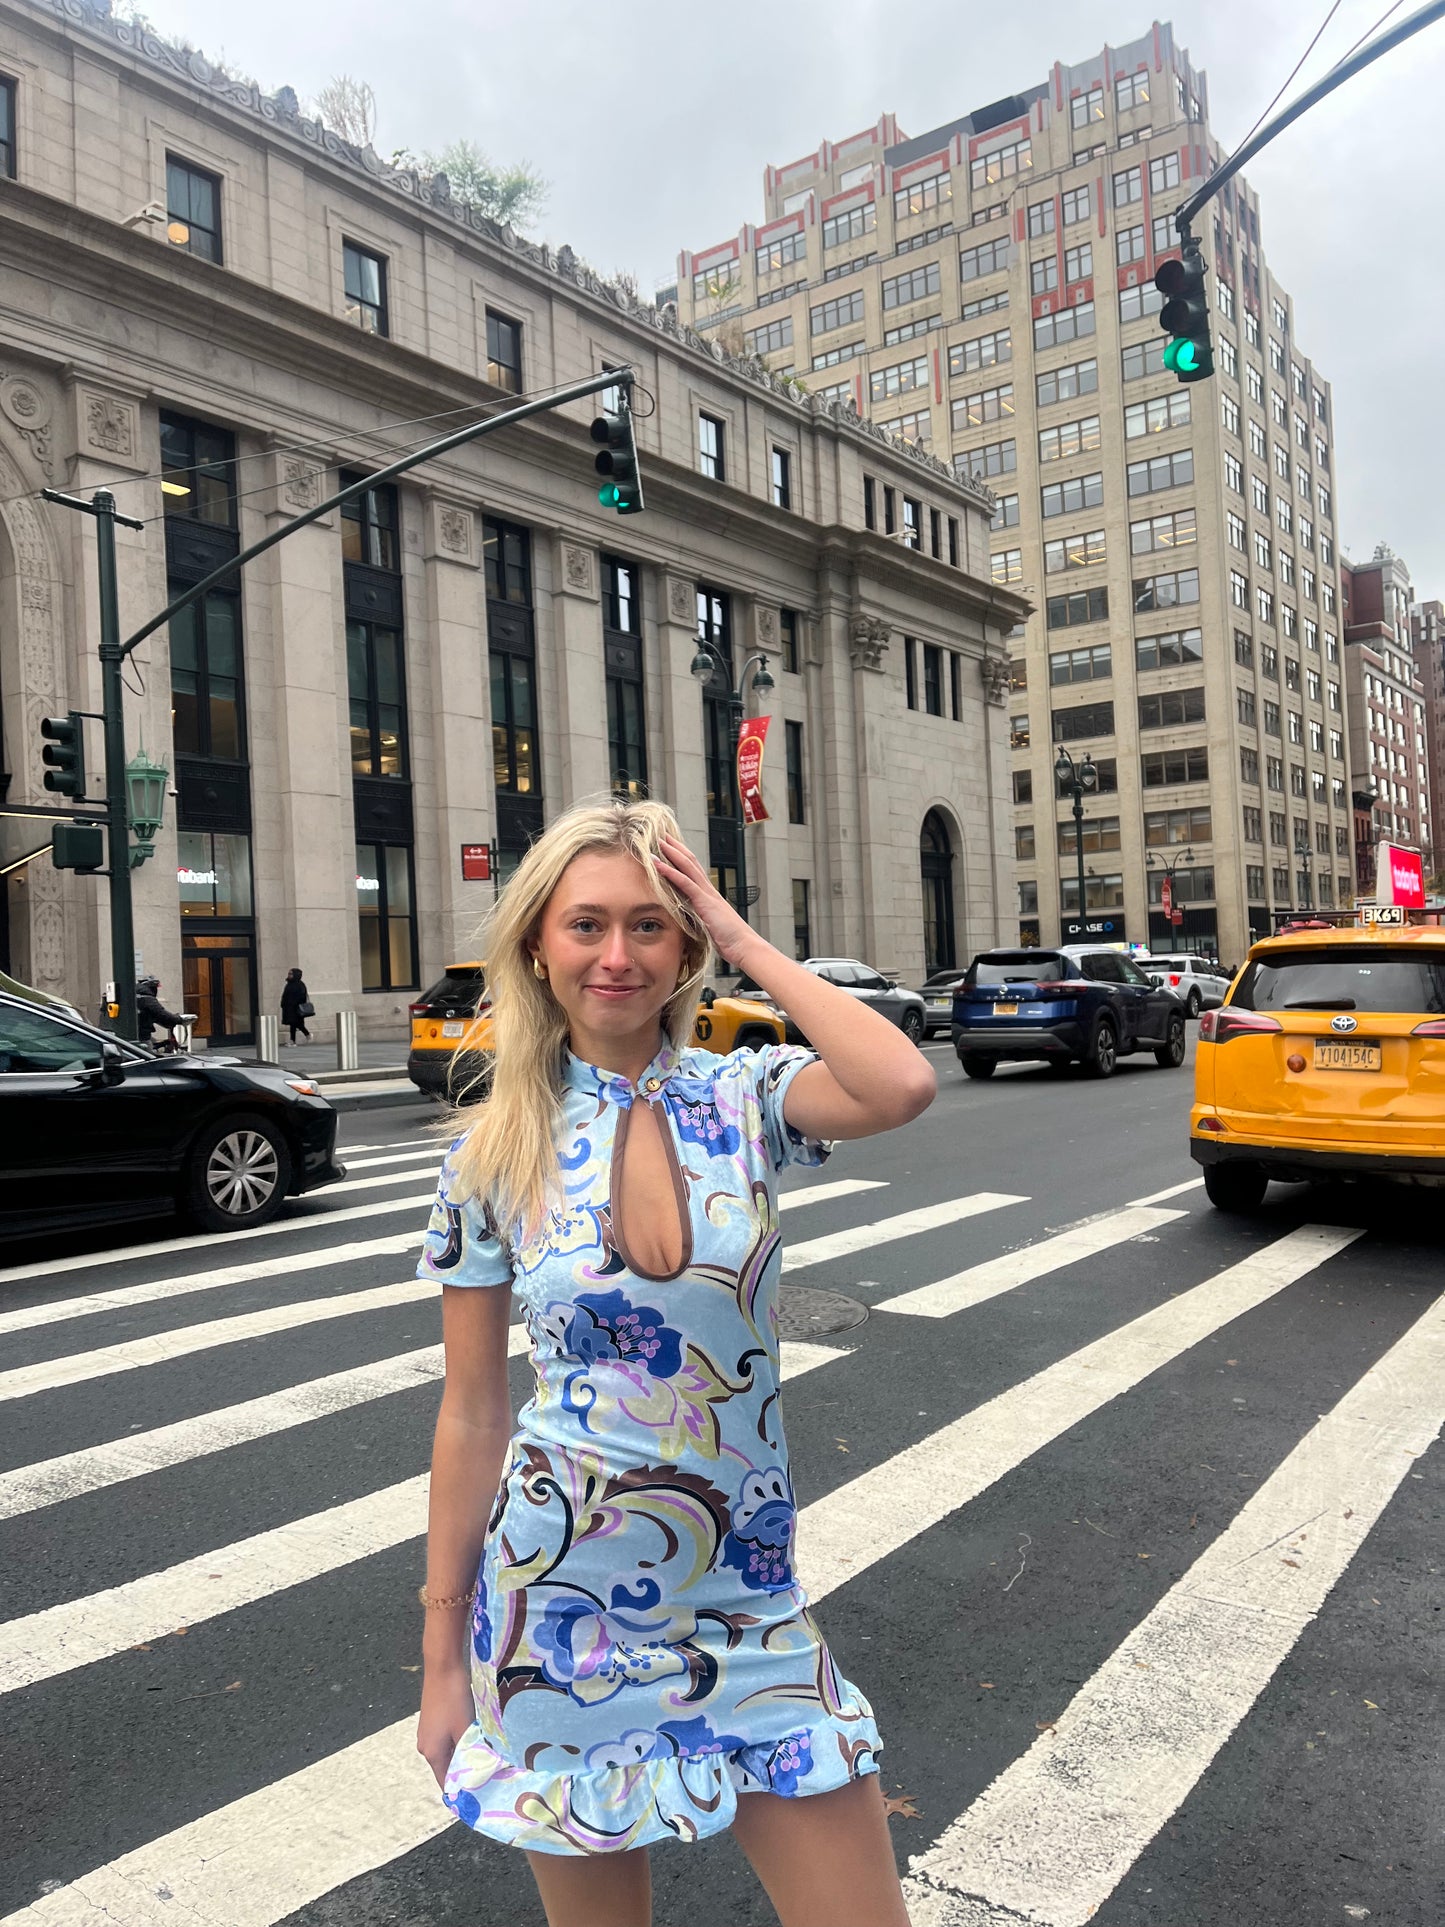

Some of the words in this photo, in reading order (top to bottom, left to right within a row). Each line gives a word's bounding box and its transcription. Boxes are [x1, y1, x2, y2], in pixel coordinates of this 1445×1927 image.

[1365, 909, 1401, 923] 3K69
[698, 1020, 708, 1038] T
[1320, 1047, 1374, 1064] Y104154C
